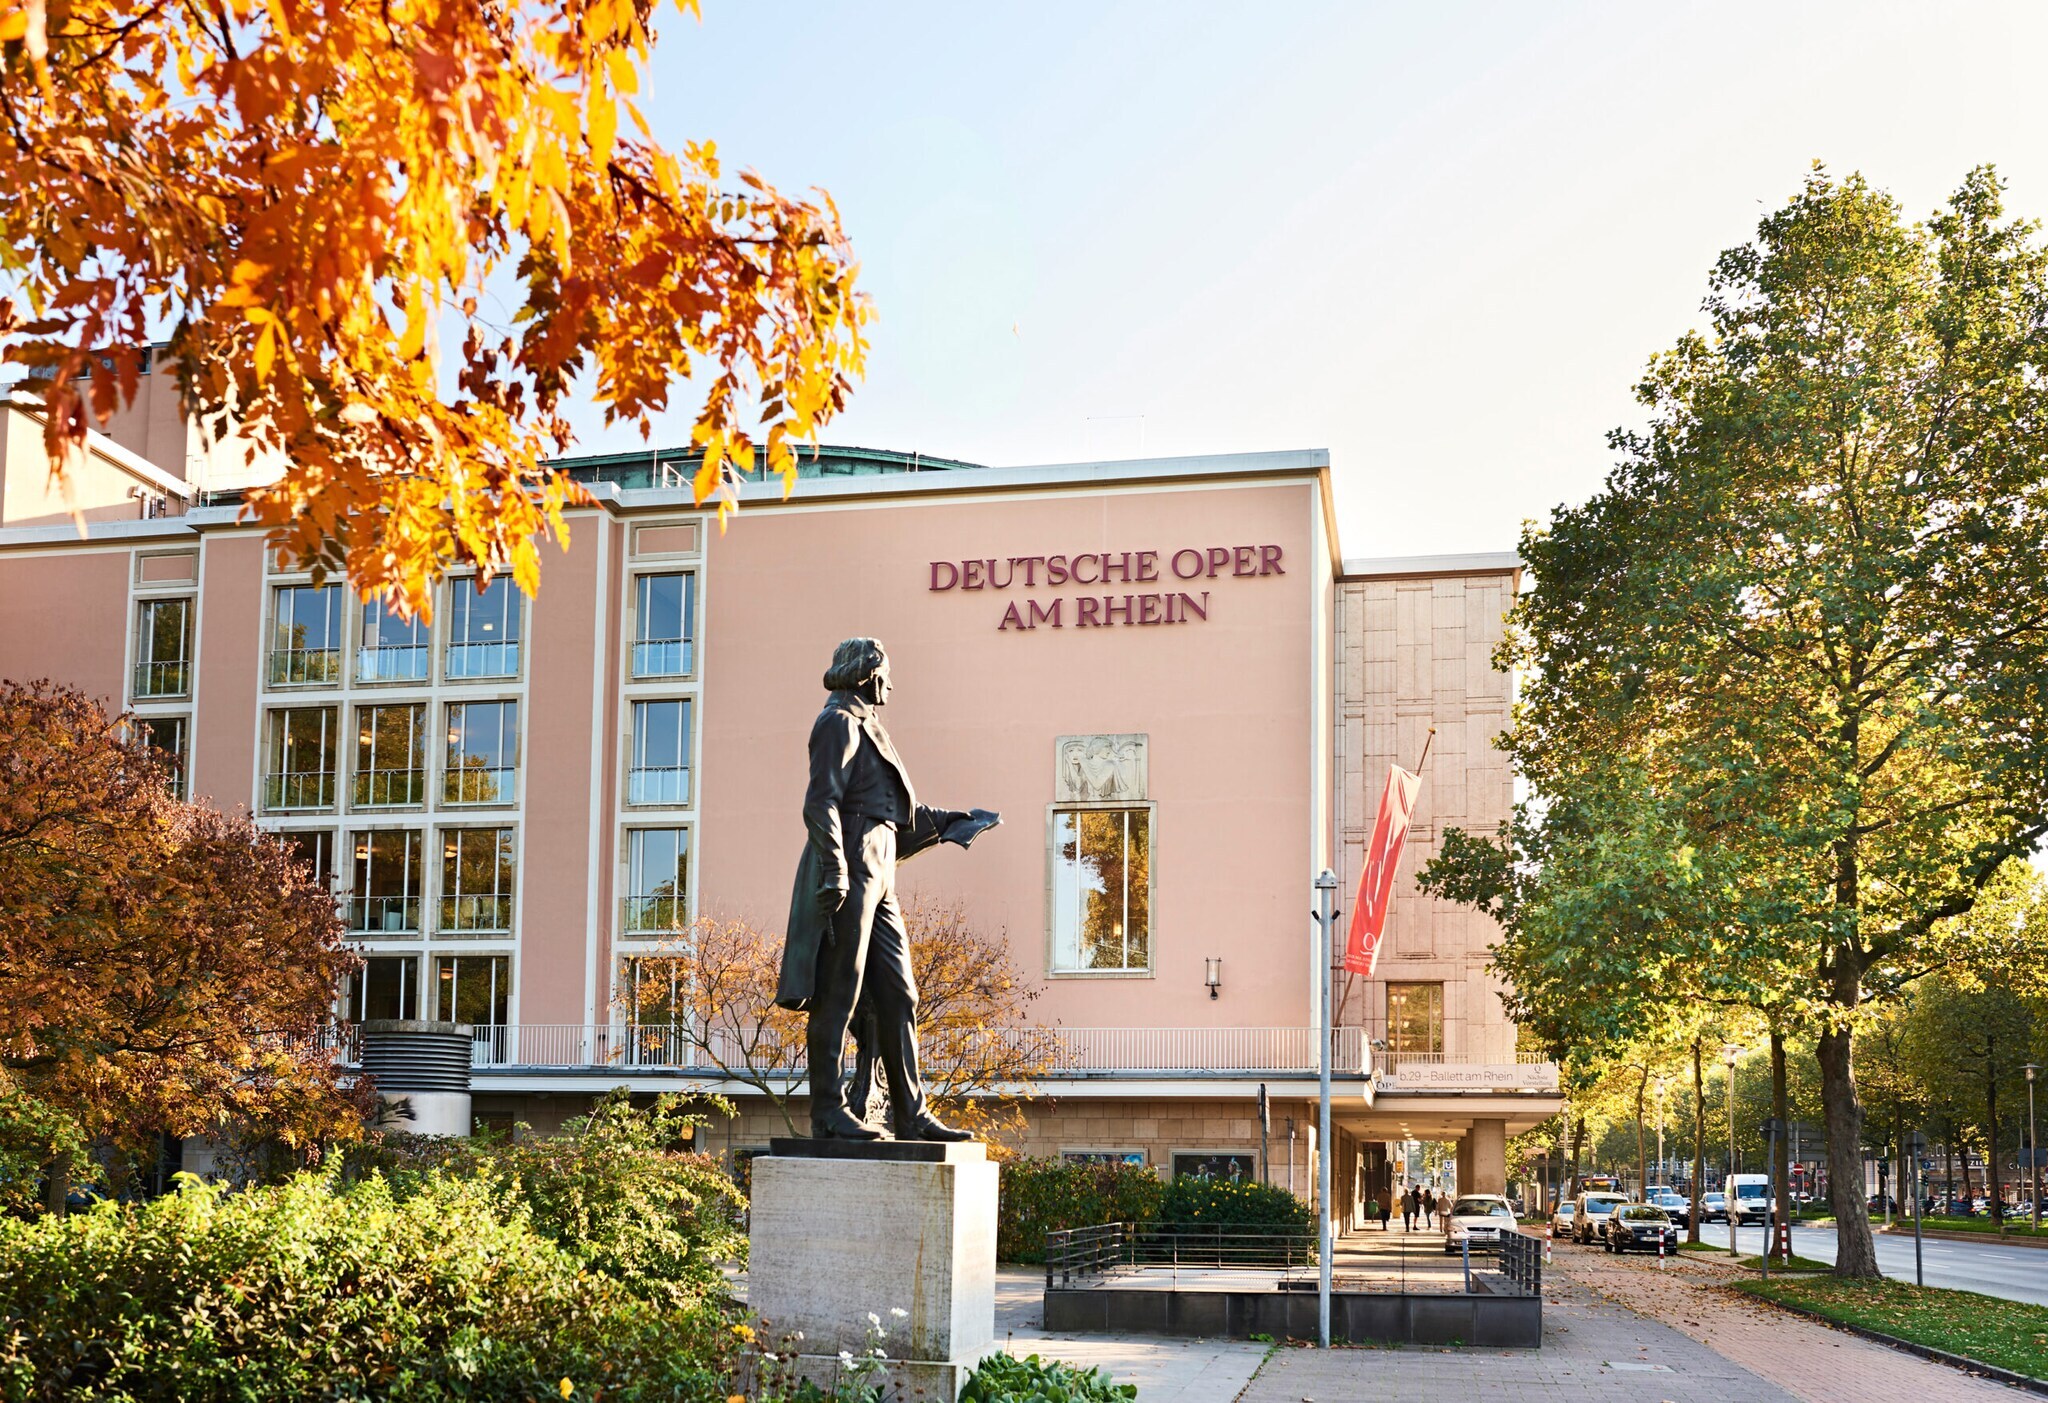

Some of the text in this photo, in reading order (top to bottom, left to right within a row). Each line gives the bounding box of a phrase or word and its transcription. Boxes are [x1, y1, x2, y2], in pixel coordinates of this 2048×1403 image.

[928, 544, 1286, 591] DEUTSCHE OPER
[997, 591, 1210, 631] AM RHEIN
[1399, 1071, 1421, 1081] b.29
[1430, 1071, 1465, 1081] Ballett
[1465, 1073, 1482, 1081] am
[1484, 1071, 1513, 1081] Rhein
